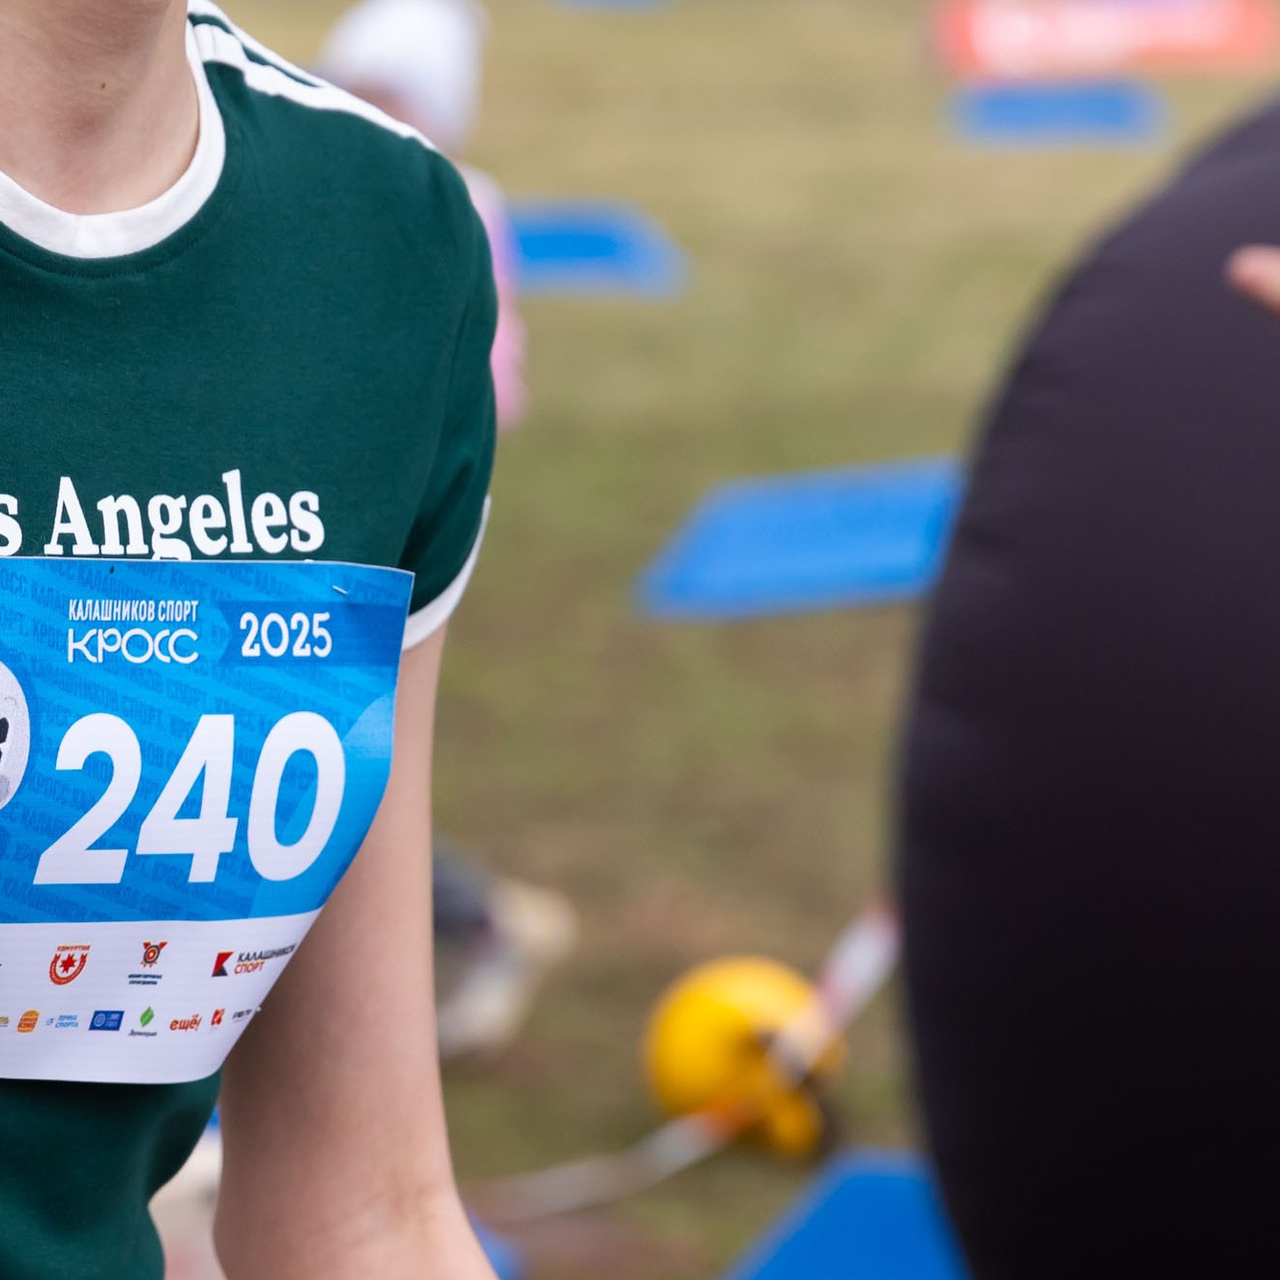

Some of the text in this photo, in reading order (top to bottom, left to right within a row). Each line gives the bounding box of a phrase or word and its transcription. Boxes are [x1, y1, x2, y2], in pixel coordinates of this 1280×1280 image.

[43, 469, 325, 561] Angeles
[69, 599, 199, 623] КАЛАШНИКОВ СПОРТ
[68, 628, 199, 664] КРОСС
[240, 611, 333, 658] 2025
[33, 711, 346, 885] 240
[234, 961, 265, 975] СПОРТ
